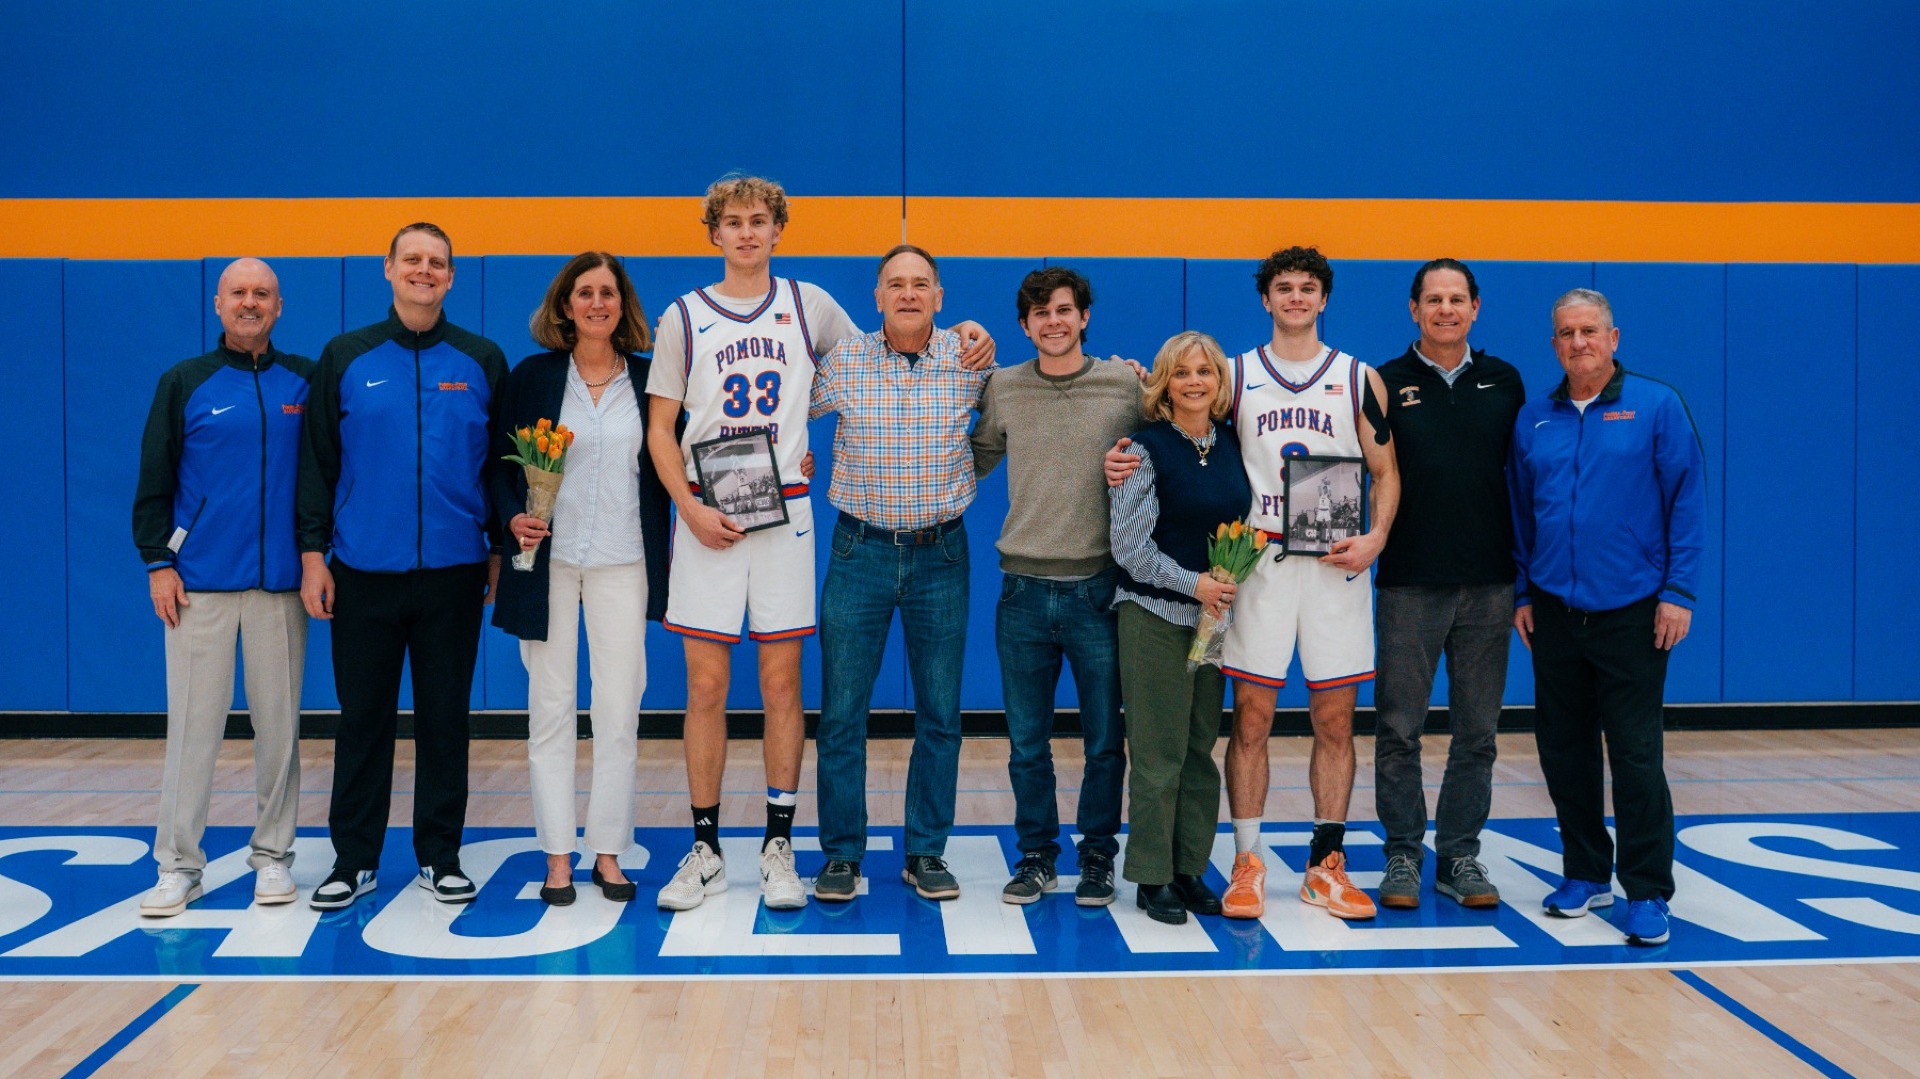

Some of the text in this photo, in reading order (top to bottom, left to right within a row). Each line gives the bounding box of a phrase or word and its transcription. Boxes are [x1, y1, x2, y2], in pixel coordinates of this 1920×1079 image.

[715, 336, 787, 374] POMONA
[723, 370, 782, 418] 33
[1257, 407, 1335, 438] POMONA
